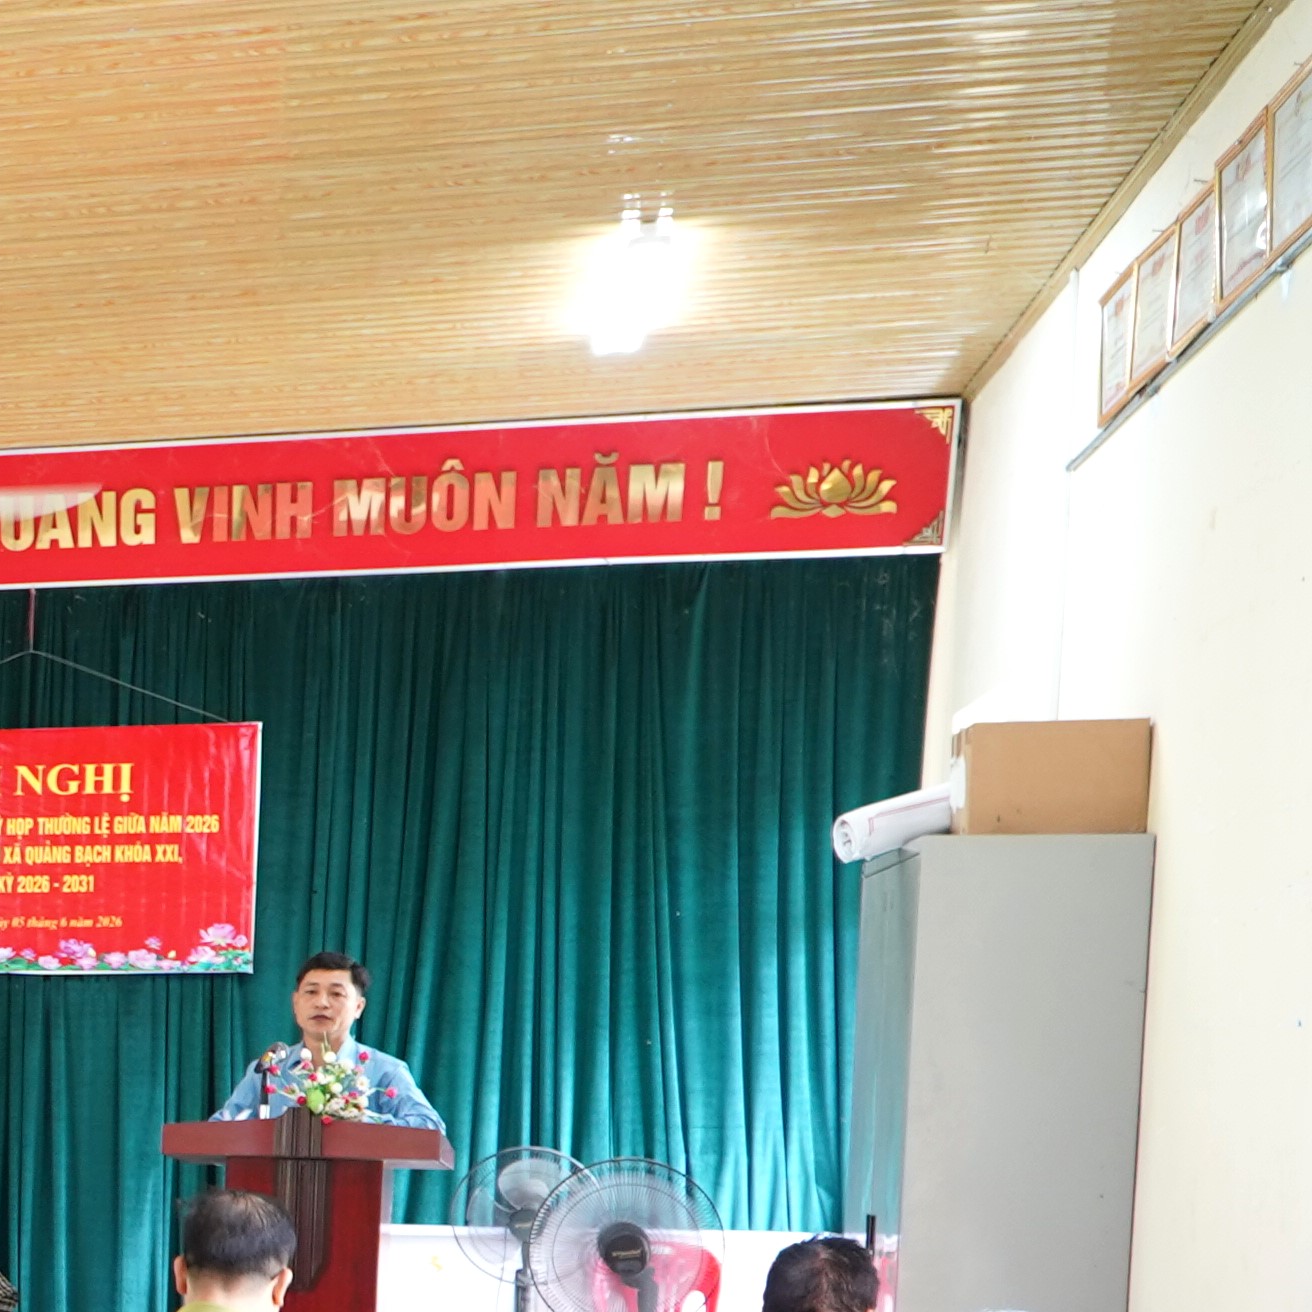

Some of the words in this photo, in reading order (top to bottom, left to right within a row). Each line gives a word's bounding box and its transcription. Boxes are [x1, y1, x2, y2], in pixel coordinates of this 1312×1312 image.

[173, 481, 314, 545] VINH
[332, 458, 518, 537] MUÔN
[536, 451, 686, 529] NĂM
[13, 763, 135, 803] NGHỊ
[7, 818, 34, 841] HỌP
[38, 813, 91, 836] THƯỜNG
[94, 813, 111, 839] LỆ
[114, 812, 147, 835] GIỮA
[150, 812, 183, 834] NĂM
[185, 815, 220, 834] 2026
[25, 840, 72, 867] QUẢNG
[75, 845, 112, 868] BẠCH
[17, 875, 51, 893] 2026
[63, 875, 95, 893] 2031
[27, 916, 59, 931] tháng
[96, 916, 123, 928] 2026
